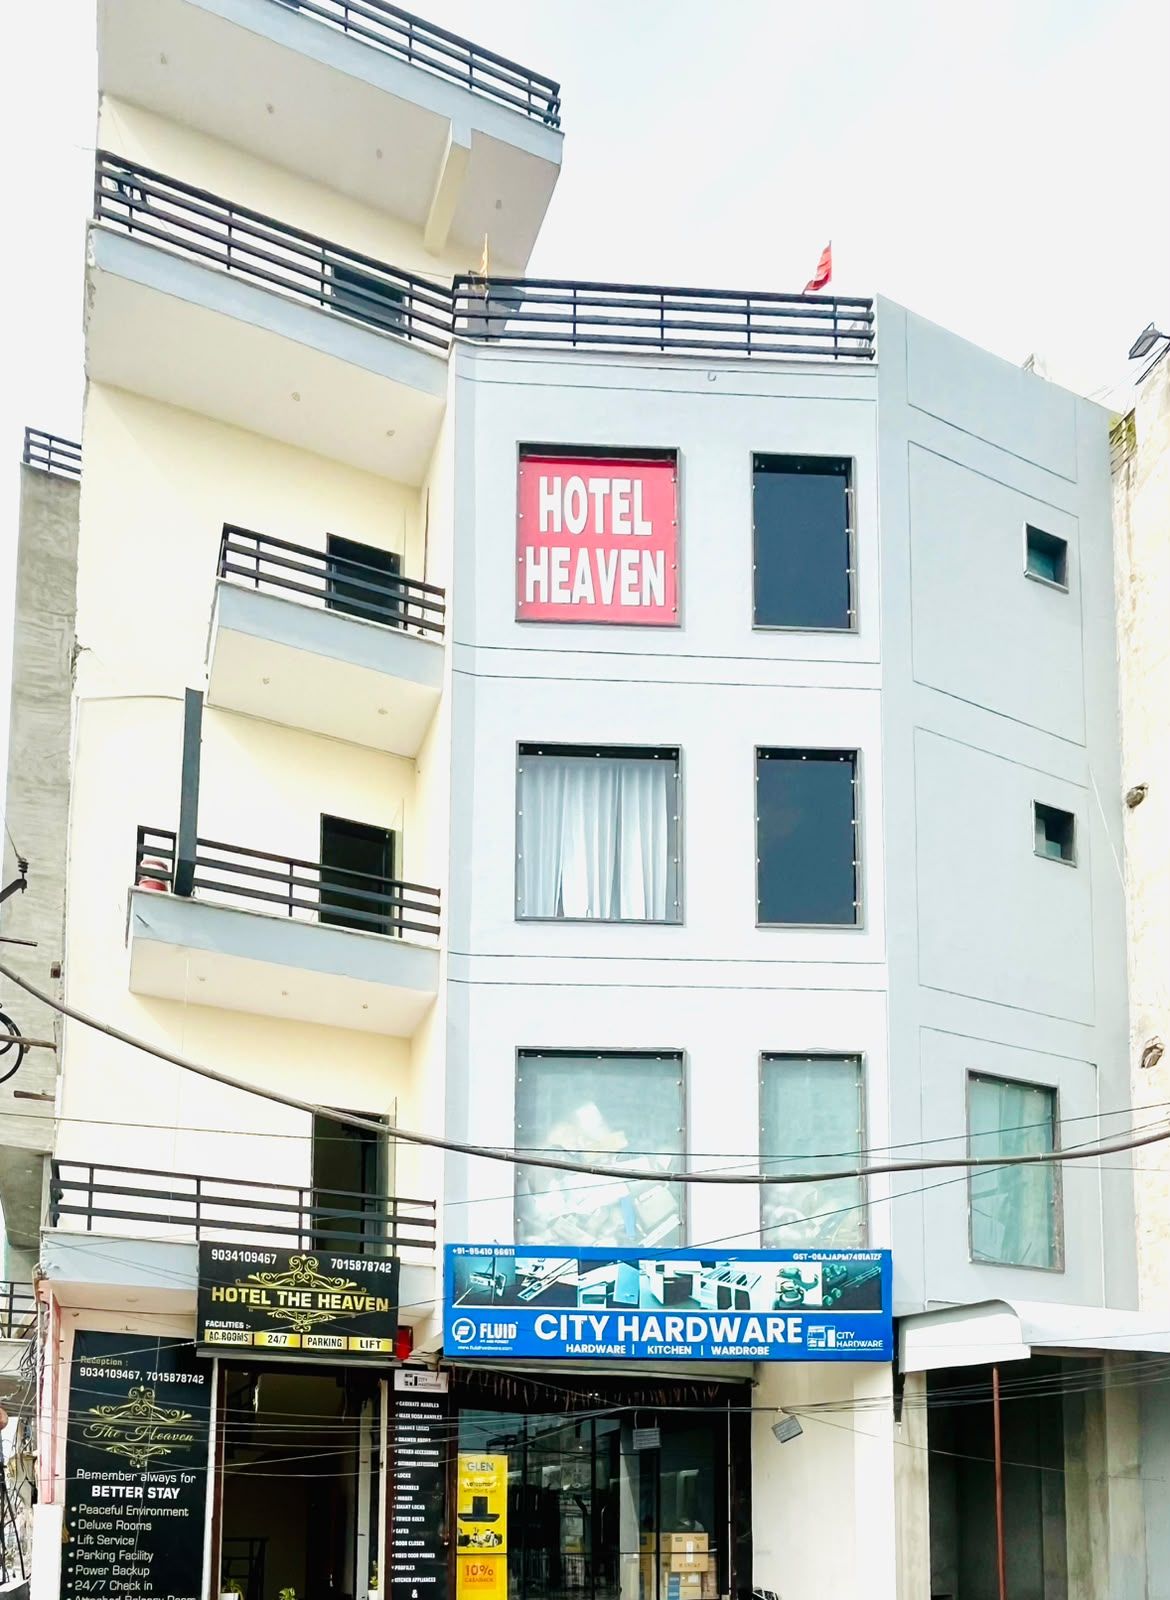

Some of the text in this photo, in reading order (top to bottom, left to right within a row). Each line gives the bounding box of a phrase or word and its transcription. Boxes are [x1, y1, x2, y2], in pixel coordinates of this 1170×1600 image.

[539, 475, 653, 536] HOTEL
[525, 546, 665, 607] HEAVEN
[211, 1249, 277, 1264] 9034109467
[330, 1258, 392, 1273] 7015878742
[211, 1287, 389, 1312] HOTEL THE HEAVEN
[205, 1320, 244, 1329] FACILITIES
[534, 1313, 803, 1344] CITY HARDWARE
[479, 1323, 517, 1340] FLUID
[836, 1331, 855, 1340] CITY
[267, 1335, 287, 1345] 24/7
[307, 1337, 342, 1348] PARKING
[359, 1340, 381, 1350] LIFT
[836, 1340, 884, 1348] HARDWARE
[566, 1344, 626, 1354] HARDWARE
[647, 1345, 692, 1355] KITCHEN
[711, 1345, 770, 1356] WARDROBE
[80, 1356, 122, 1367] Reception
[80, 1367, 205, 1384] 9034109467, 7015878742
[83, 1423, 195, 1442] The Heaven
[467, 1461, 494, 1471] GLEN
[76, 1468, 196, 1485] Remember always for
[91, 1485, 180, 1499] BETTER STAY
[78, 1504, 189, 1517] Peaceful Environment
[78, 1519, 152, 1531] Deluxe Rooms
[77, 1534, 135, 1545] Lift Service
[76, 1550, 154, 1562] Parking Facility
[75, 1565, 150, 1577] Power Backup
[465, 1564, 494, 1576] 10%
[74, 1580, 153, 1592] 24/7 Check in
[411, 1588, 418, 1599] &
